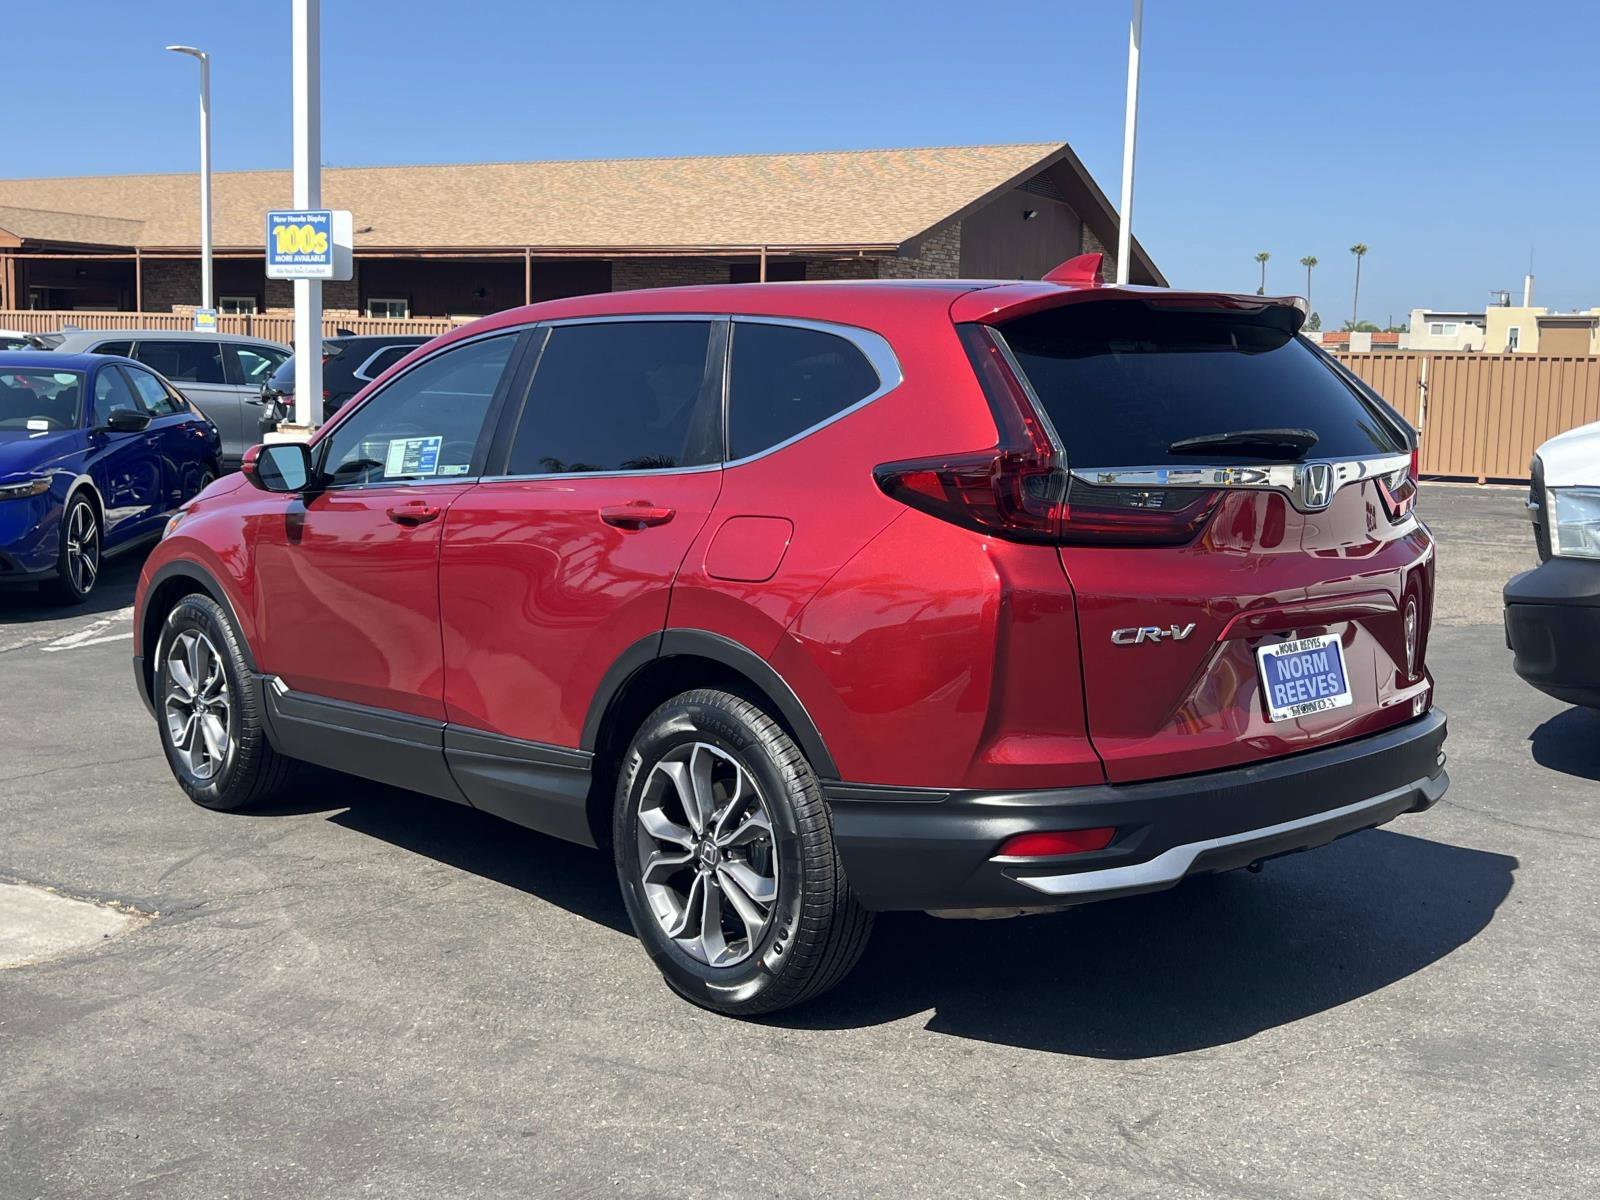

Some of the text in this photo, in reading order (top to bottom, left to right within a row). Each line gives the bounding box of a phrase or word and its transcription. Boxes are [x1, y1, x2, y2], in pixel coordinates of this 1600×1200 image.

[1110, 622, 1196, 645] CR-V
[1300, 638, 1321, 651] REEVES
[1276, 652, 1329, 681] NORM
[1274, 672, 1339, 706] REEVES
